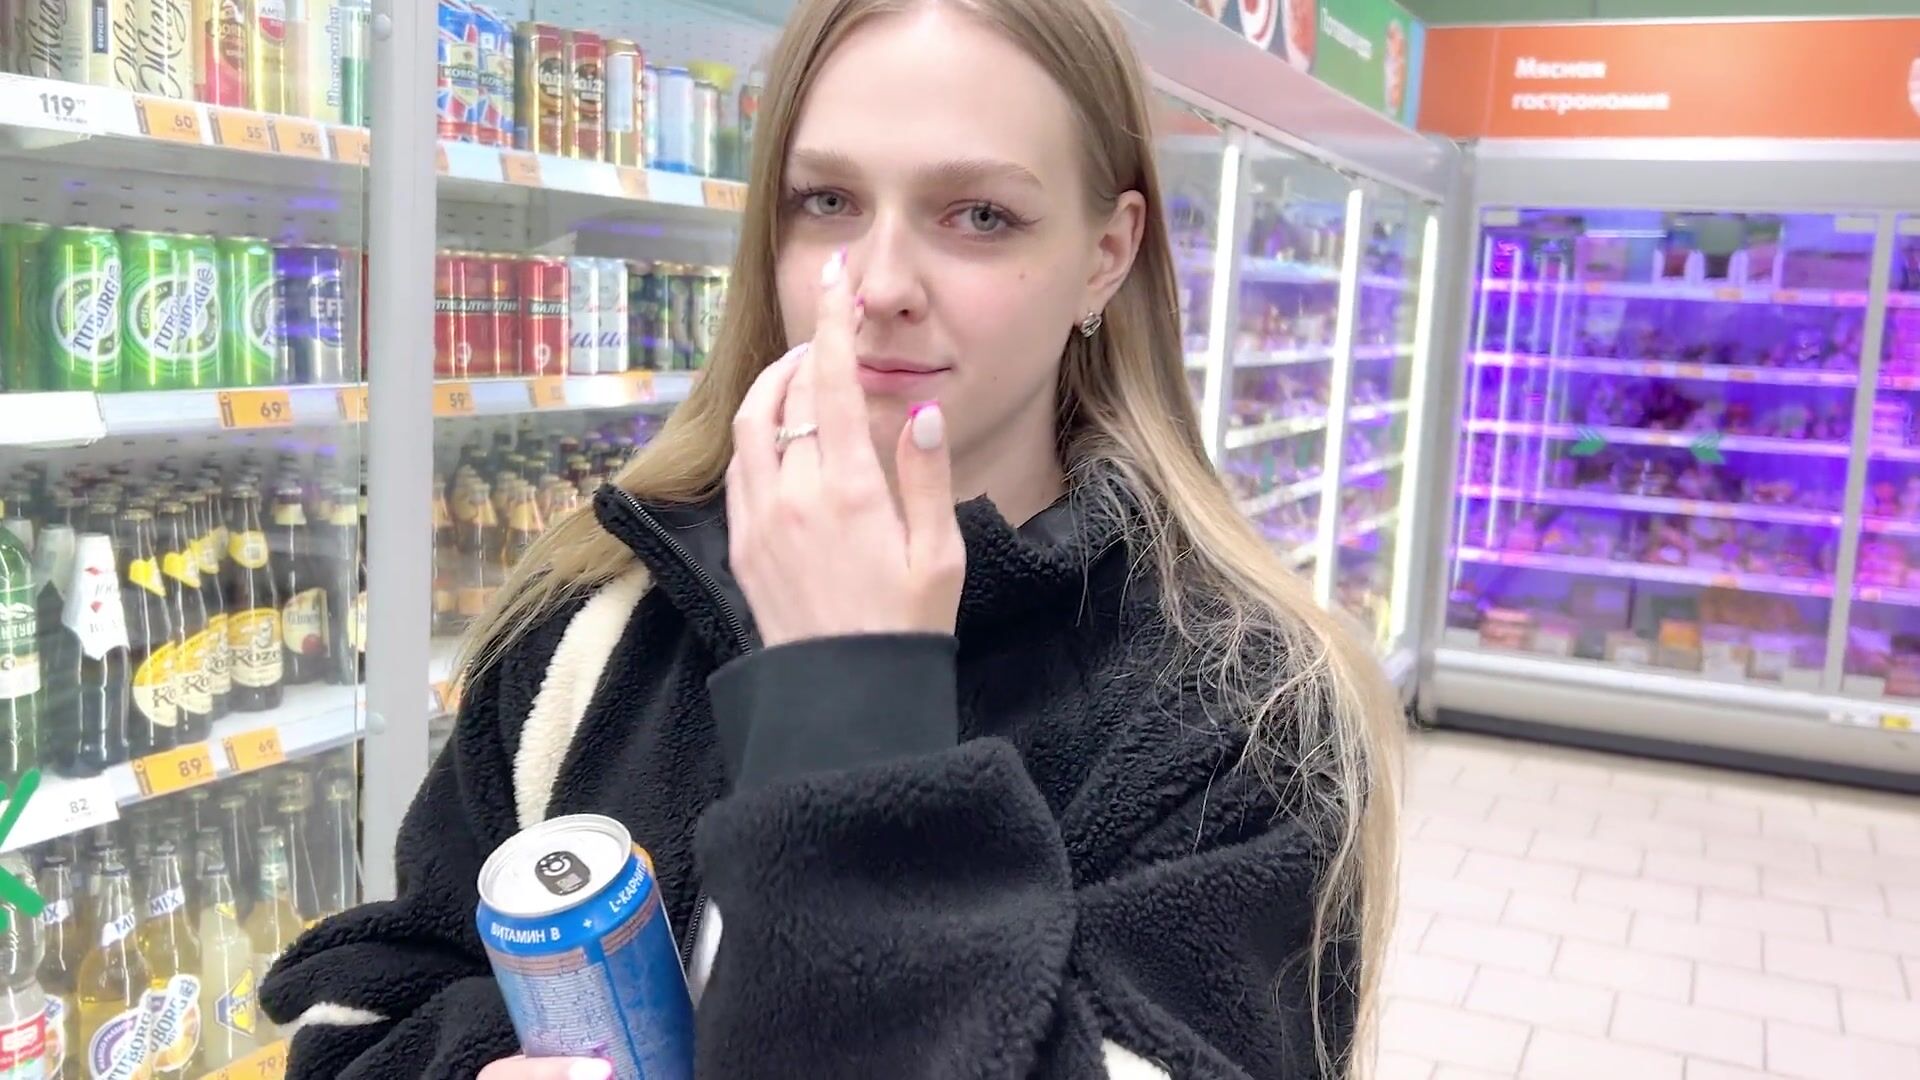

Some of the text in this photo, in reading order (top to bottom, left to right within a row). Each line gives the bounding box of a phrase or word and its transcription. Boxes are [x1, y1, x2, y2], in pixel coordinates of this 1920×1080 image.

[40, 93, 75, 116] 119
[175, 114, 193, 129] 60
[449, 392, 466, 408] 59
[260, 402, 282, 418] 69
[258, 740, 274, 753] 69
[178, 757, 202, 777] 89
[69, 798, 90, 815] 82
[150, 894, 179, 915] MIX
[490, 922, 546, 944] ВИТАМИН
